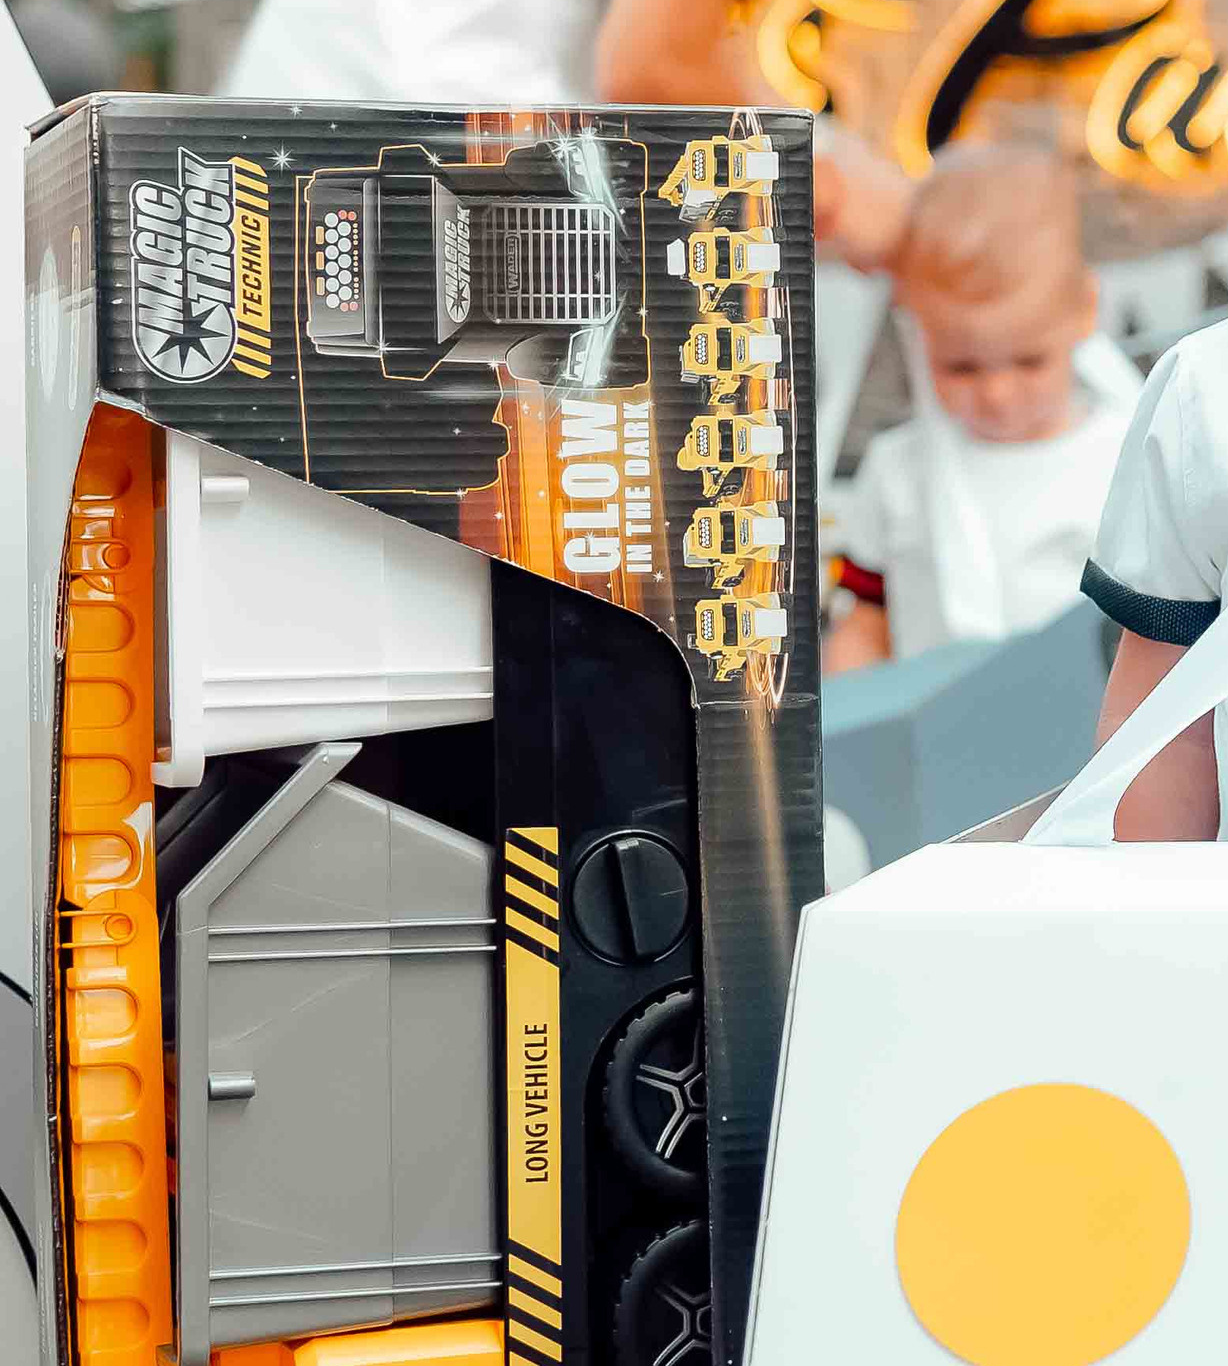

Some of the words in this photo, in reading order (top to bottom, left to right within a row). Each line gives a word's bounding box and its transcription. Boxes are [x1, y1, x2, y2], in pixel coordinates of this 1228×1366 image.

[136, 185, 184, 334] MAGIC
[184, 156, 233, 304] TRUCK
[241, 215, 262, 317] TECHNIC
[444, 220, 458, 299] MAGIC
[457, 203, 471, 284] TRUCK
[507, 238, 519, 289] WADER
[625, 401, 653, 478] DARK
[561, 399, 621, 574] GLOW
[625, 484, 654, 536] THE
[625, 542, 654, 574] IN
[524, 1022, 549, 1119] VEHICLE
[525, 1123, 549, 1184] LONG
